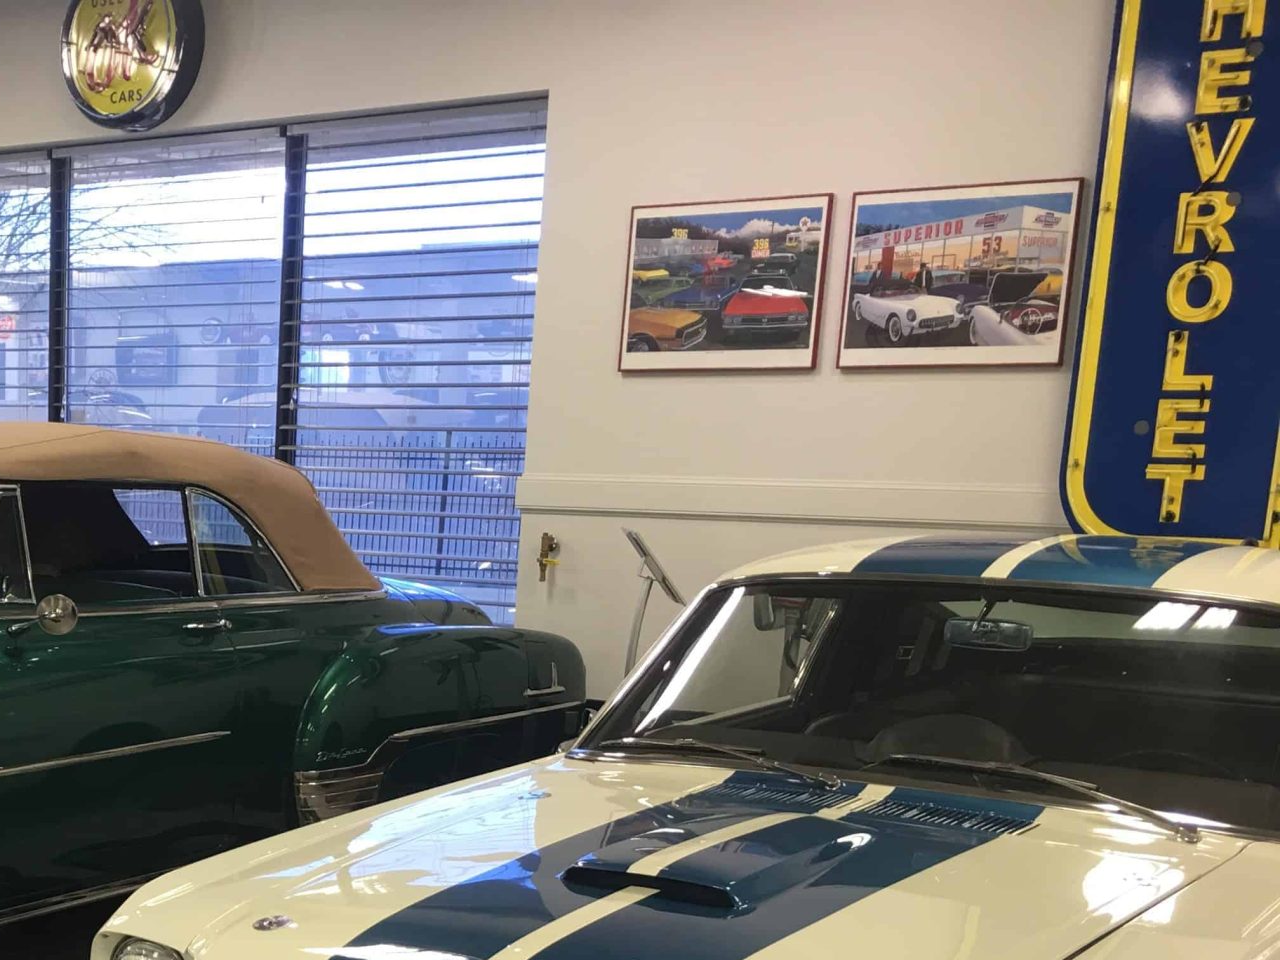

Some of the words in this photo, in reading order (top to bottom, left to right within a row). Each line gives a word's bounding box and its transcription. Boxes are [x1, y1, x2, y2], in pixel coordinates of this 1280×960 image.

[110, 89, 143, 104] CARS
[672, 228, 689, 240] 396
[883, 219, 964, 246] SUPERIOR
[753, 238, 769, 250] 396
[982, 236, 1002, 255] 53
